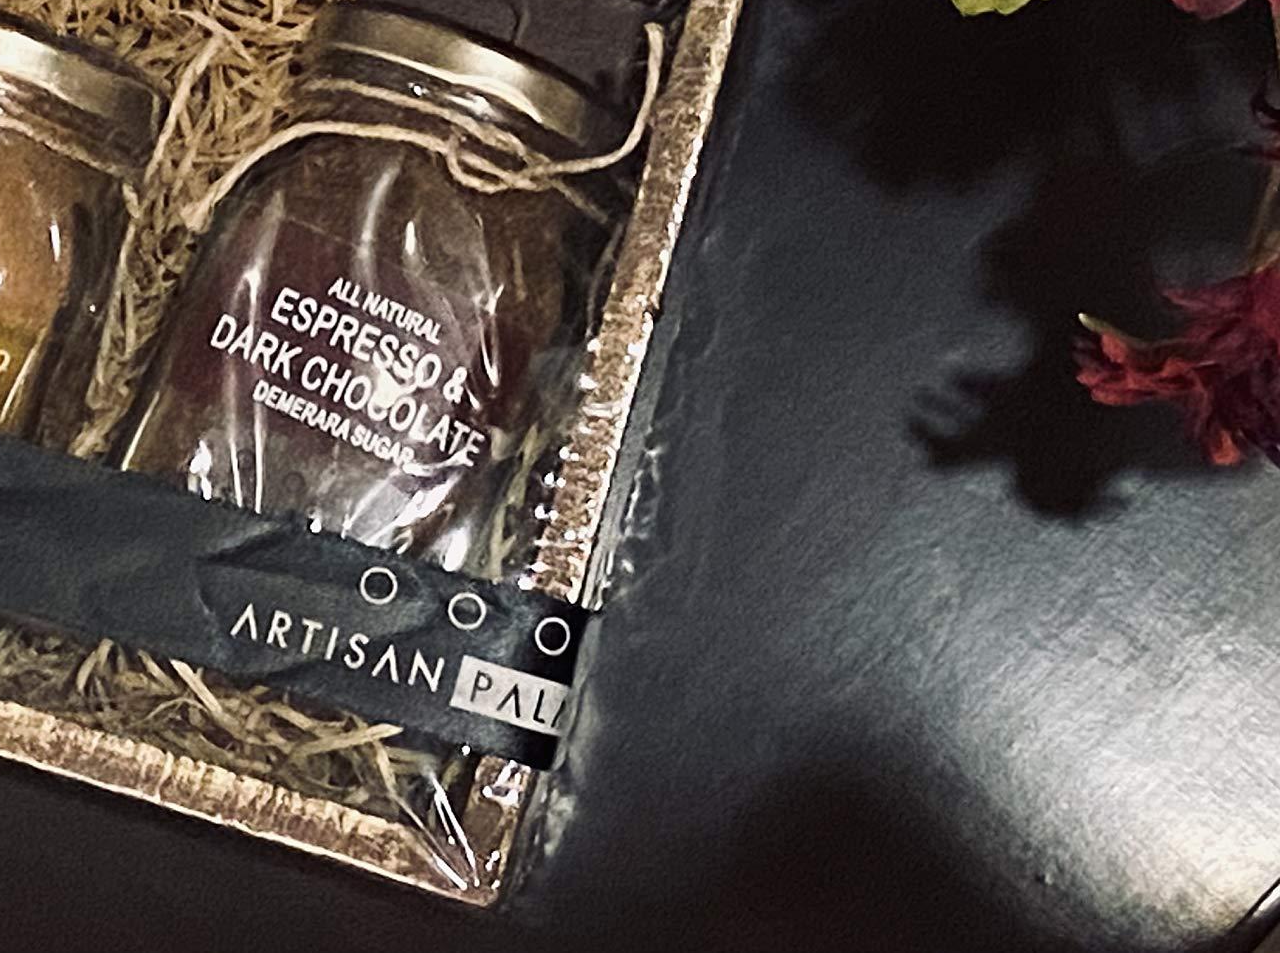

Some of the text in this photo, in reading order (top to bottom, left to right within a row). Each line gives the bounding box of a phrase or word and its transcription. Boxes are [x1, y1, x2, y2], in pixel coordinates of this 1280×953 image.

[209, 312, 303, 381] DARK
[271, 286, 469, 405] ESPRESSO &
[327, 276, 442, 346] ALL NATURAL
[252, 378, 417, 469] DEMERARA SUGAR
[229, 602, 445, 693] ARTISAN
